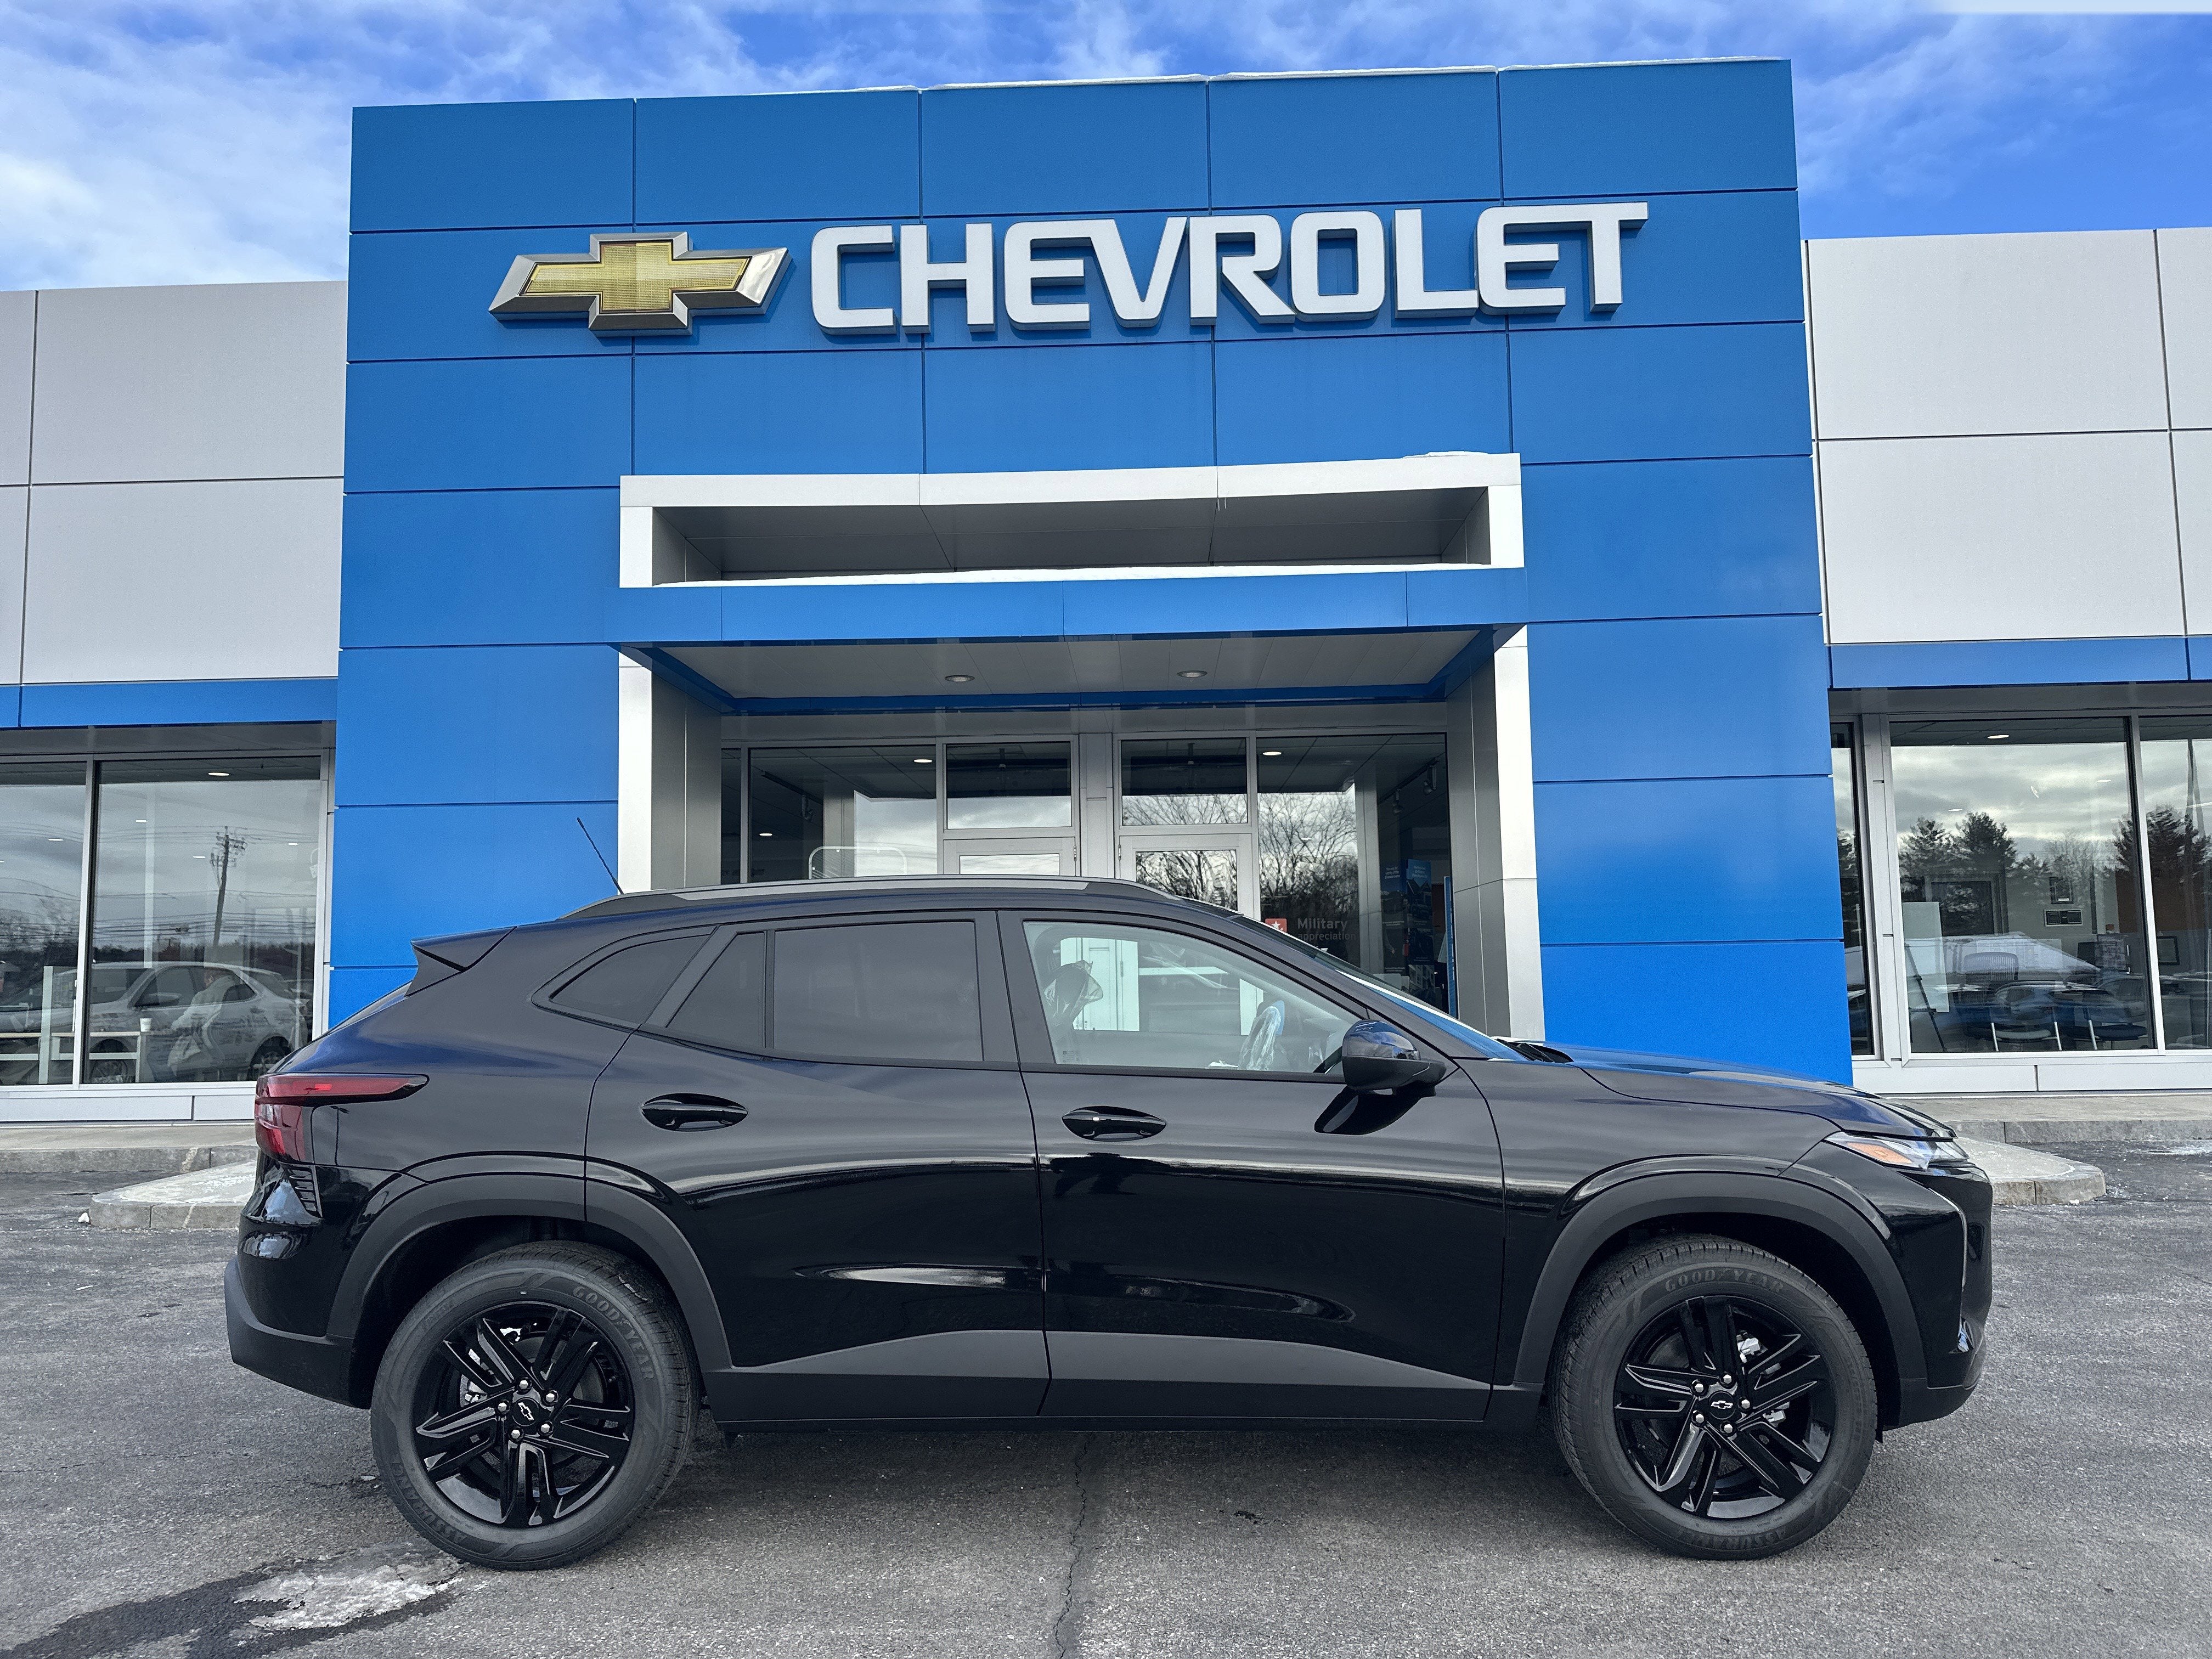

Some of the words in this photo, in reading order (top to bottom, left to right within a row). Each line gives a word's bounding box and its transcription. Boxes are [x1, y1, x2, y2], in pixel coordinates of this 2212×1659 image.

[811, 202, 1649, 335] CHEVROLET
[1297, 918, 1347, 932] Military
[1298, 932, 1356, 941] appreciation
